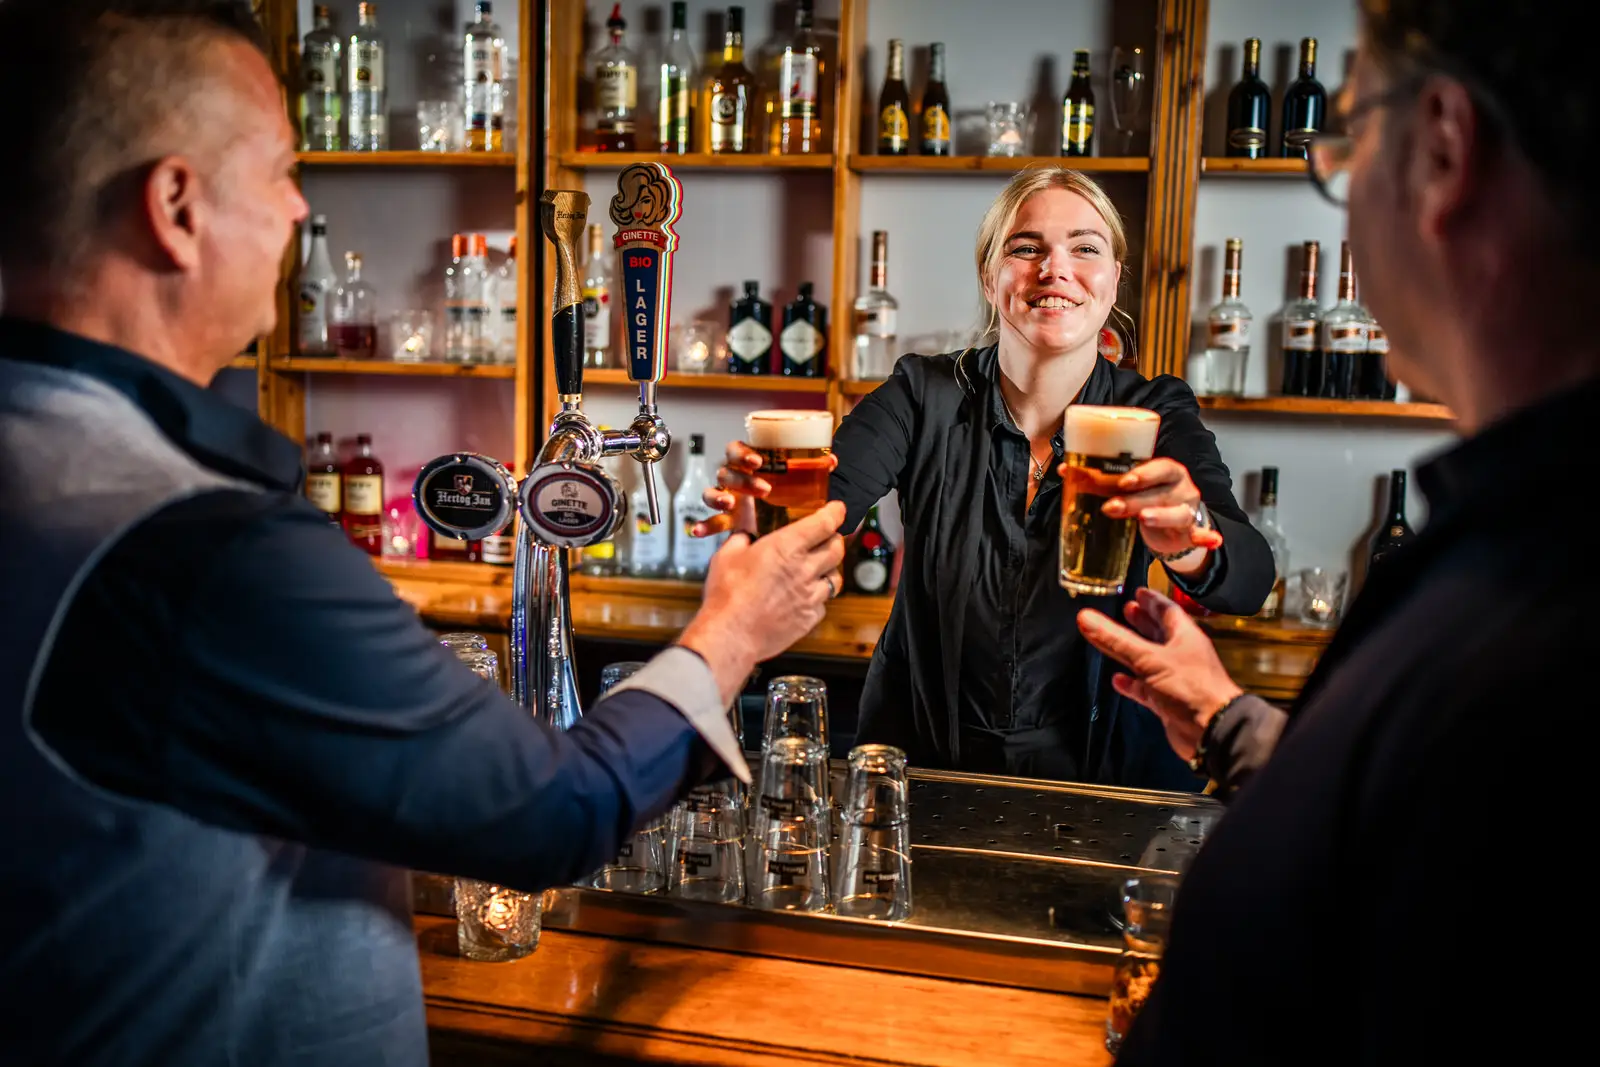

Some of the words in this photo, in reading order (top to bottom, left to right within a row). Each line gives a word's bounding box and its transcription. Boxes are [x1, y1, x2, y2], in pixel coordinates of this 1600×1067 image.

[622, 231, 659, 242] GINETTE
[629, 255, 652, 268] BIO
[635, 279, 648, 360] LAGER
[436, 490, 471, 507] Hertog
[471, 493, 492, 507] Jan
[551, 499, 589, 511] GINETTE
